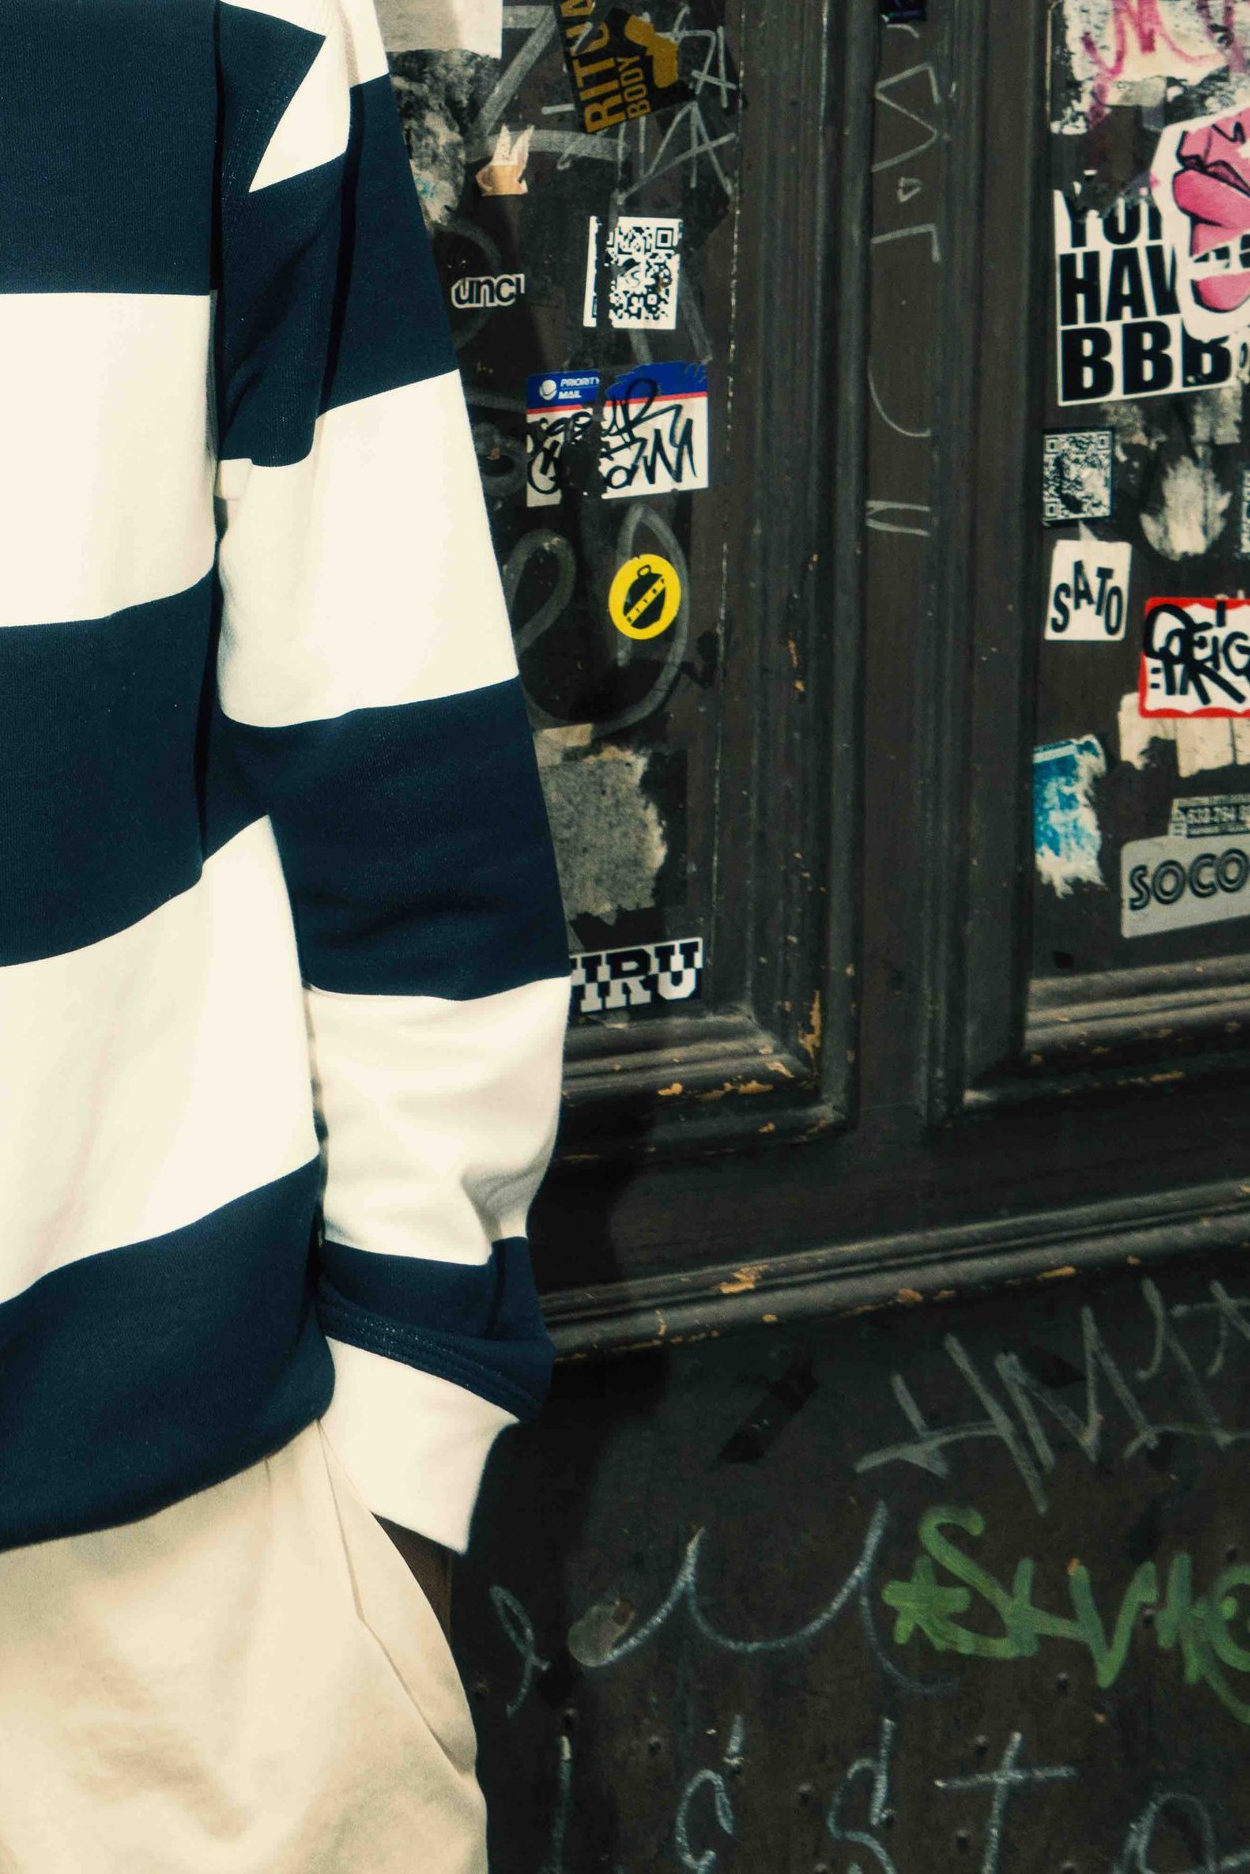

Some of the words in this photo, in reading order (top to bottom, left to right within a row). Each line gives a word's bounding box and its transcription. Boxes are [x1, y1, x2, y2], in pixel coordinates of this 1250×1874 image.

[617, 55, 652, 120] BODY
[1059, 243, 1182, 327] HAV
[557, 390, 583, 400] MAIL
[560, 376, 600, 387] PRIORITY
[1050, 559, 1123, 637] SATO
[569, 941, 700, 1013] IRU
